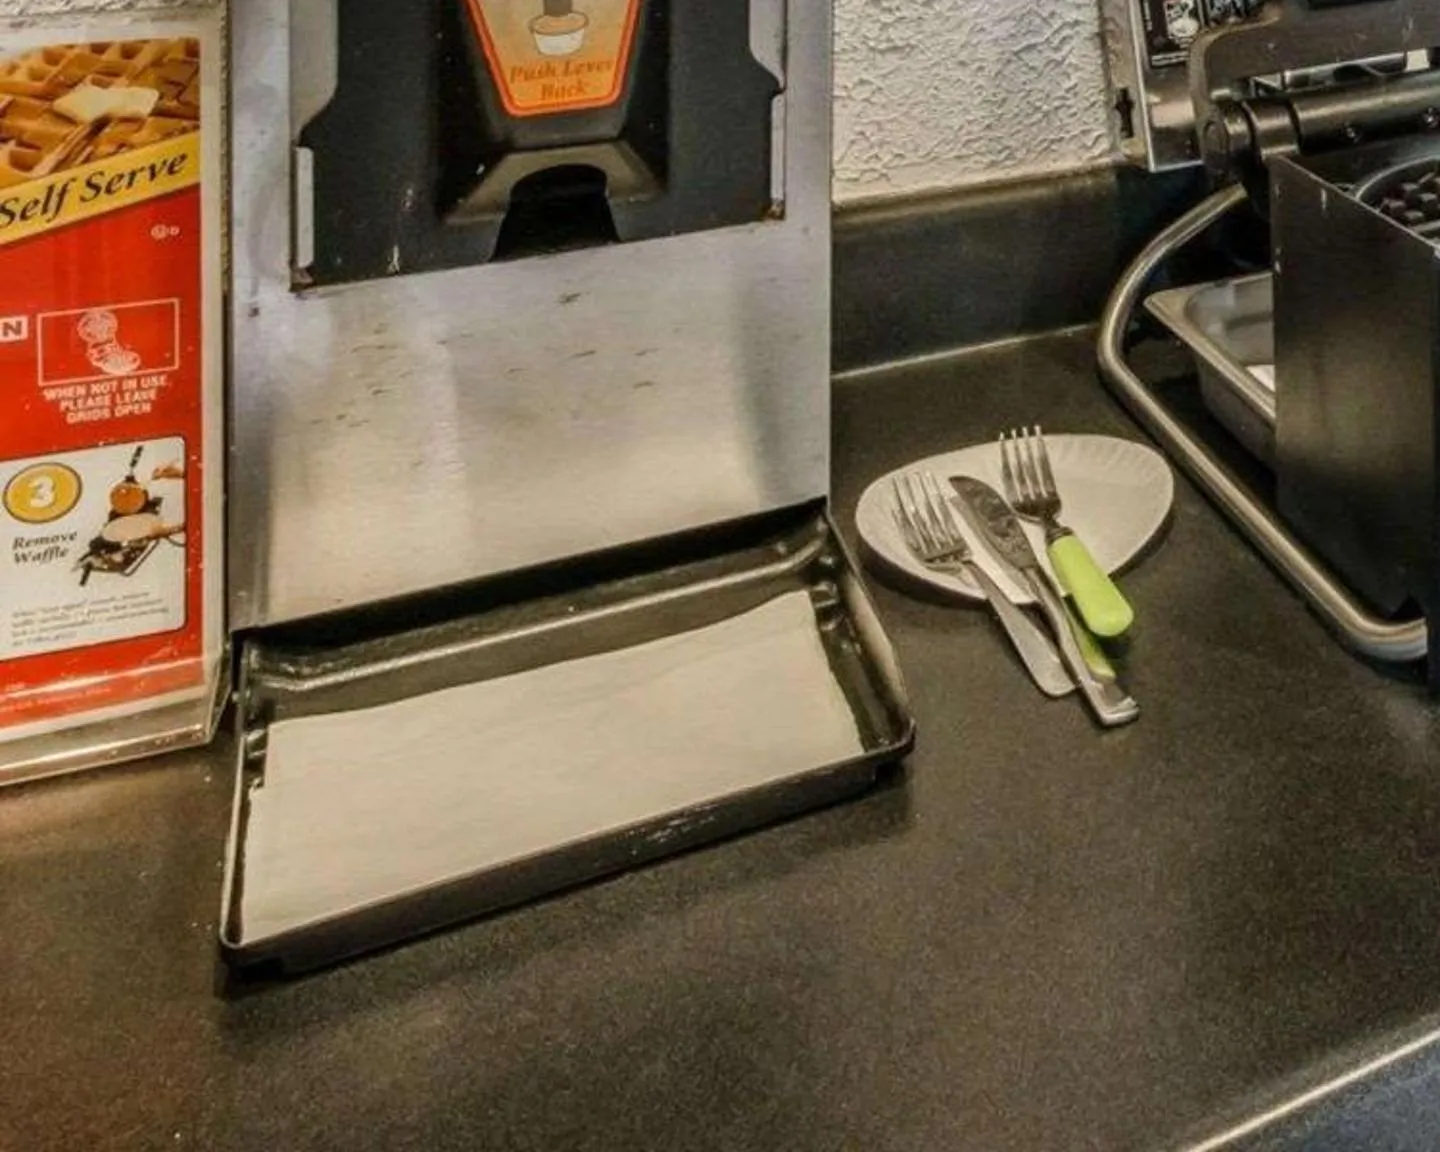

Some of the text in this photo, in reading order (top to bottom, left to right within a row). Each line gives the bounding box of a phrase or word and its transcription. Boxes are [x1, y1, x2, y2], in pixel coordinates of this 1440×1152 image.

[509, 60, 556, 85] Push
[0, 152, 189, 227] Self Serve
[43, 373, 168, 401] WHEN NOT IN USE
[59, 393, 112, 412] PLEASE
[28, 475, 56, 509] 3
[13, 531, 78, 551] Remove
[14, 546, 70, 569] Waffle
